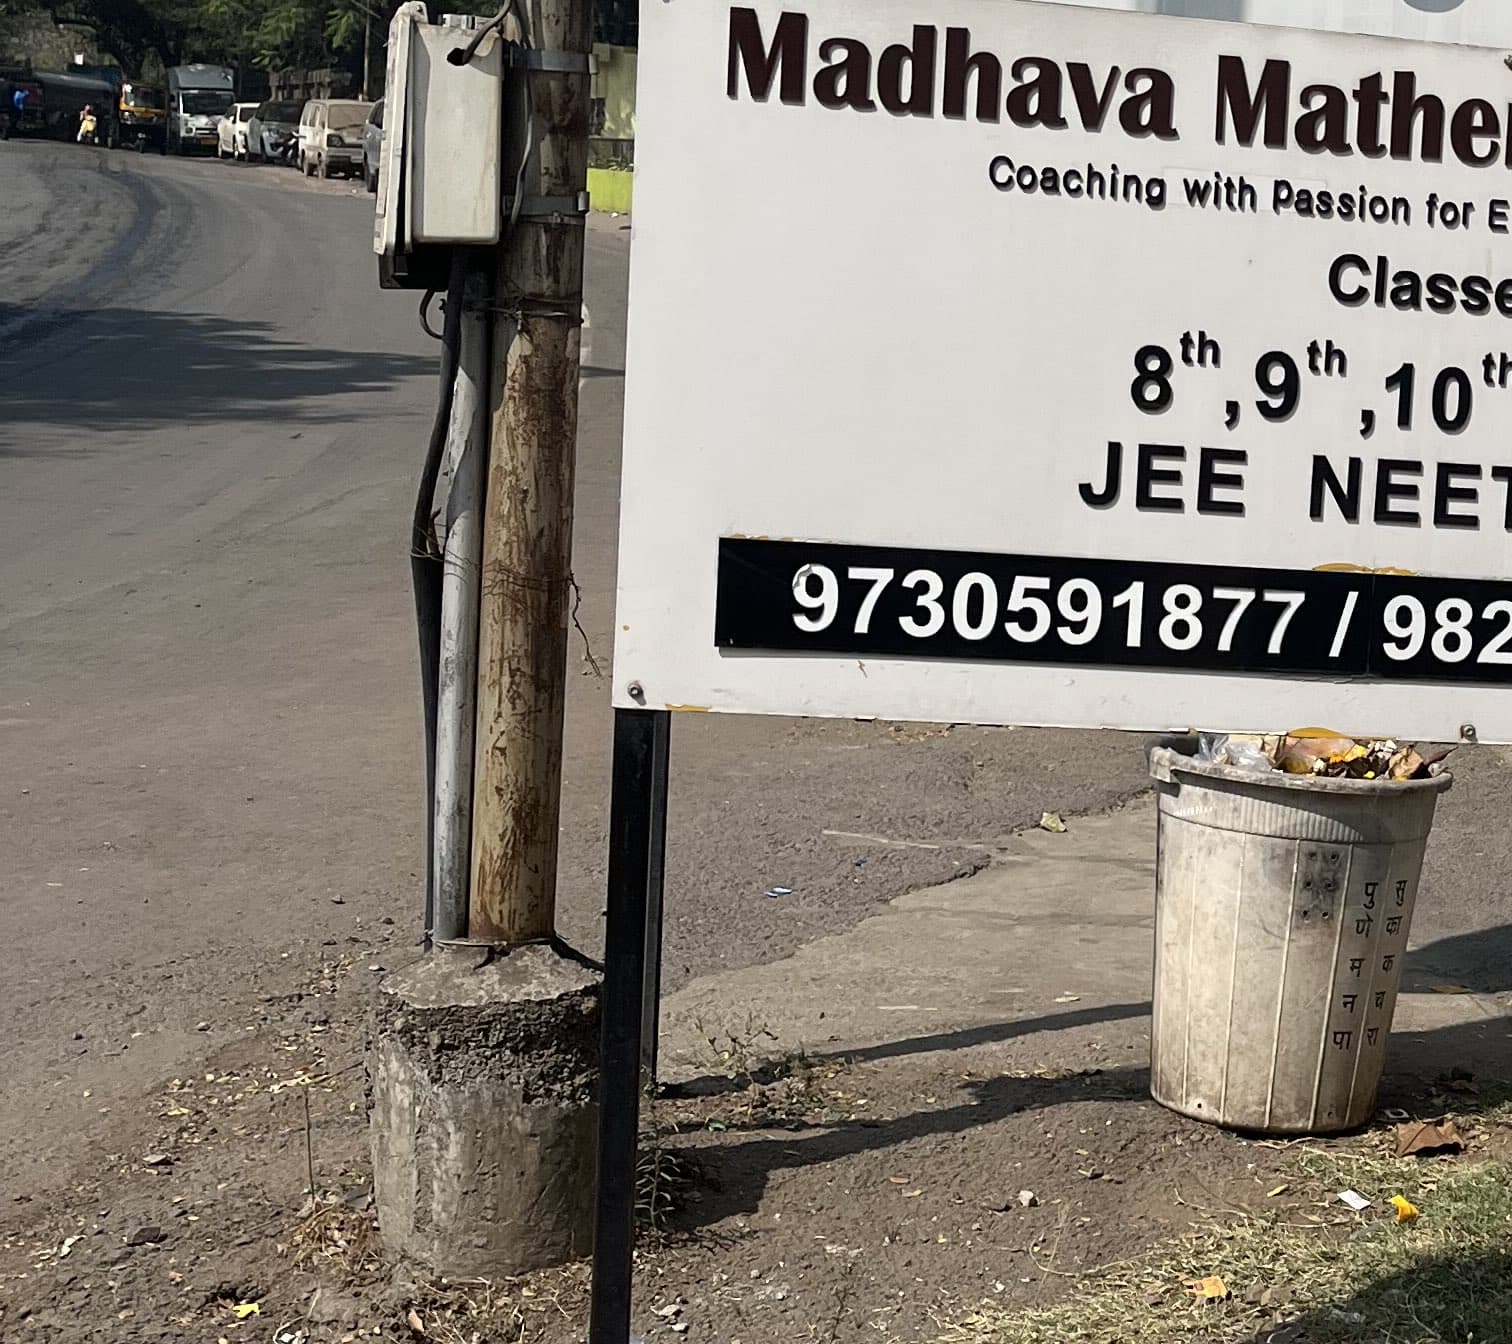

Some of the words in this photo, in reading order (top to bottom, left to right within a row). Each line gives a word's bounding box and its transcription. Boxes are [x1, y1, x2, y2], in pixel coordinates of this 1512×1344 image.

[726, 5, 1180, 142] Madhava
[987, 154, 1168, 212] Coaching
[1183, 171, 1258, 213] with
[1271, 177, 1411, 226] Passion
[1425, 192, 1475, 230] for
[1077, 440, 1249, 518] JEE
[791, 562, 1307, 655] 9730591877
[1328, 590, 1360, 658] /
